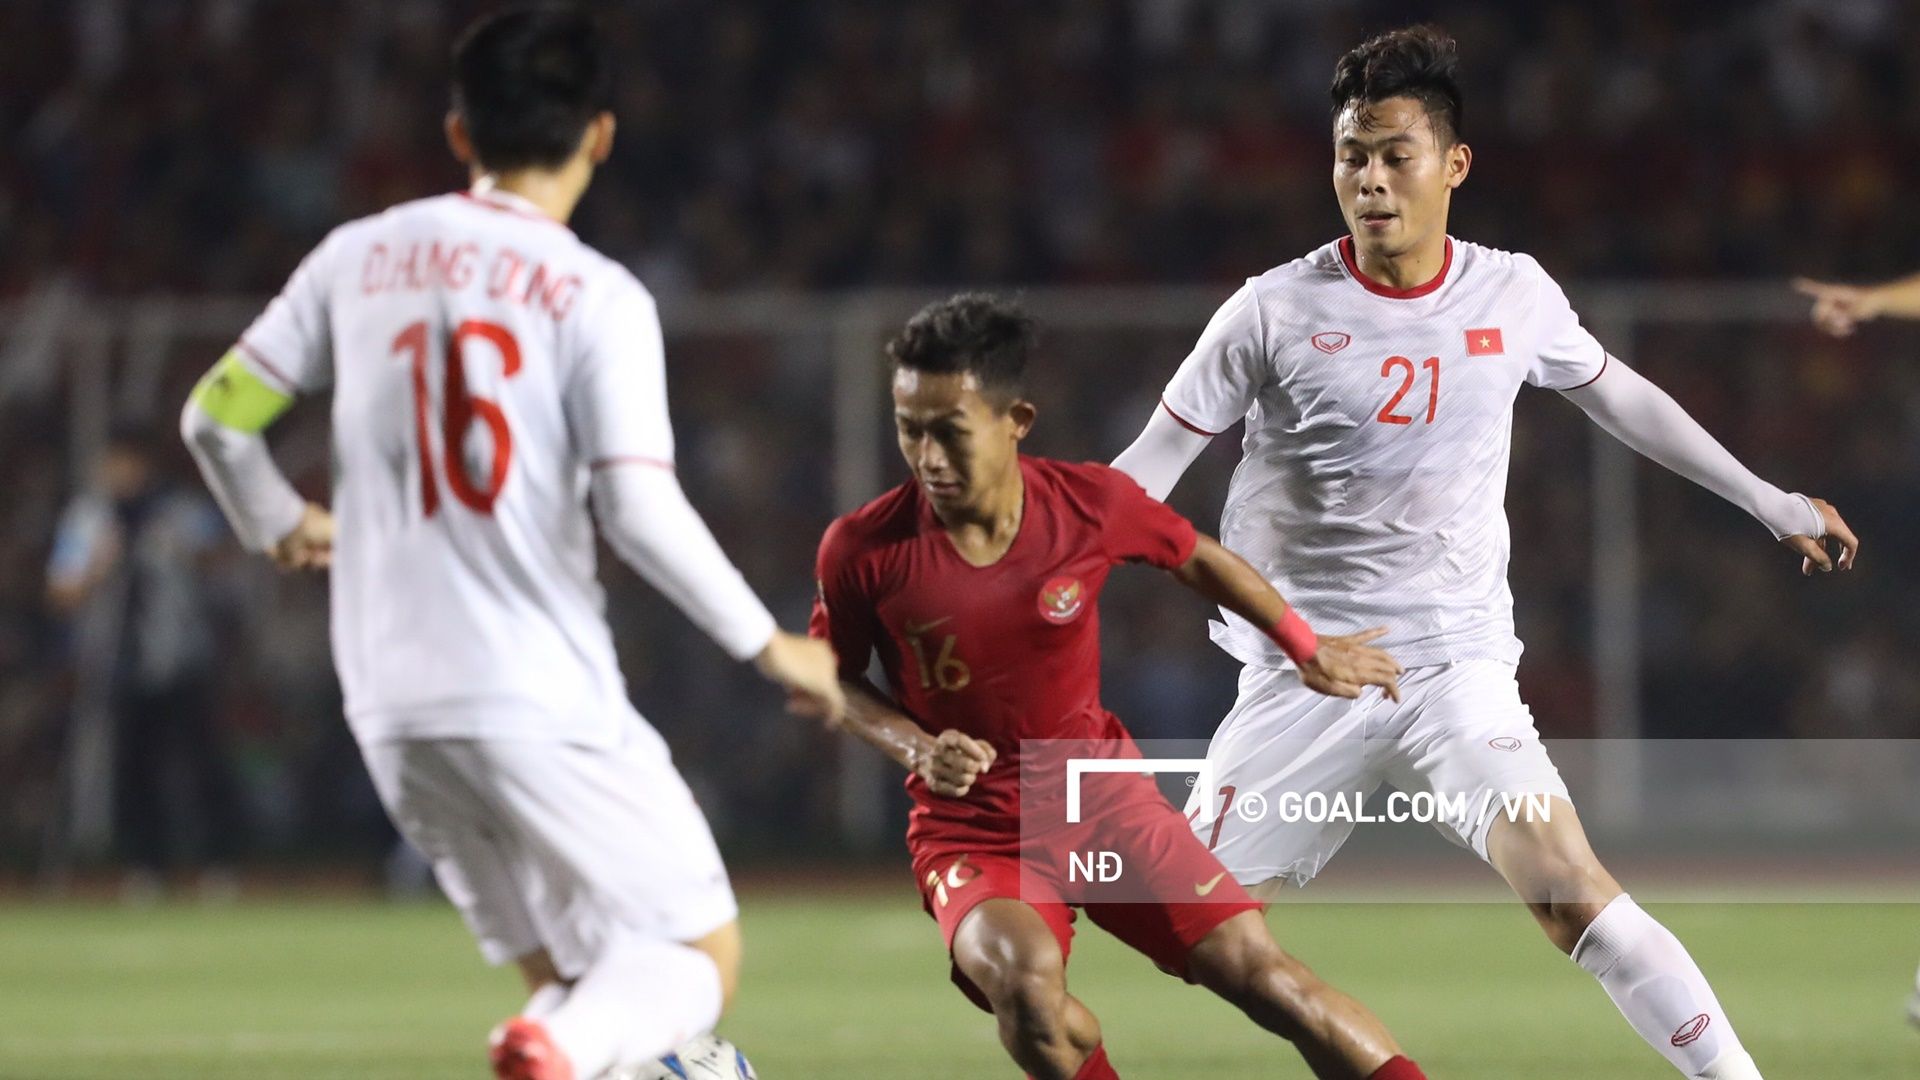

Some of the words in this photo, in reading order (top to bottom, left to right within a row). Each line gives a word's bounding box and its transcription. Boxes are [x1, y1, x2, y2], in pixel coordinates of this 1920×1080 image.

[391, 319, 523, 518] 16
[1377, 355, 1440, 424] 21
[908, 634, 971, 691] 16
[926, 853, 984, 908] 16
